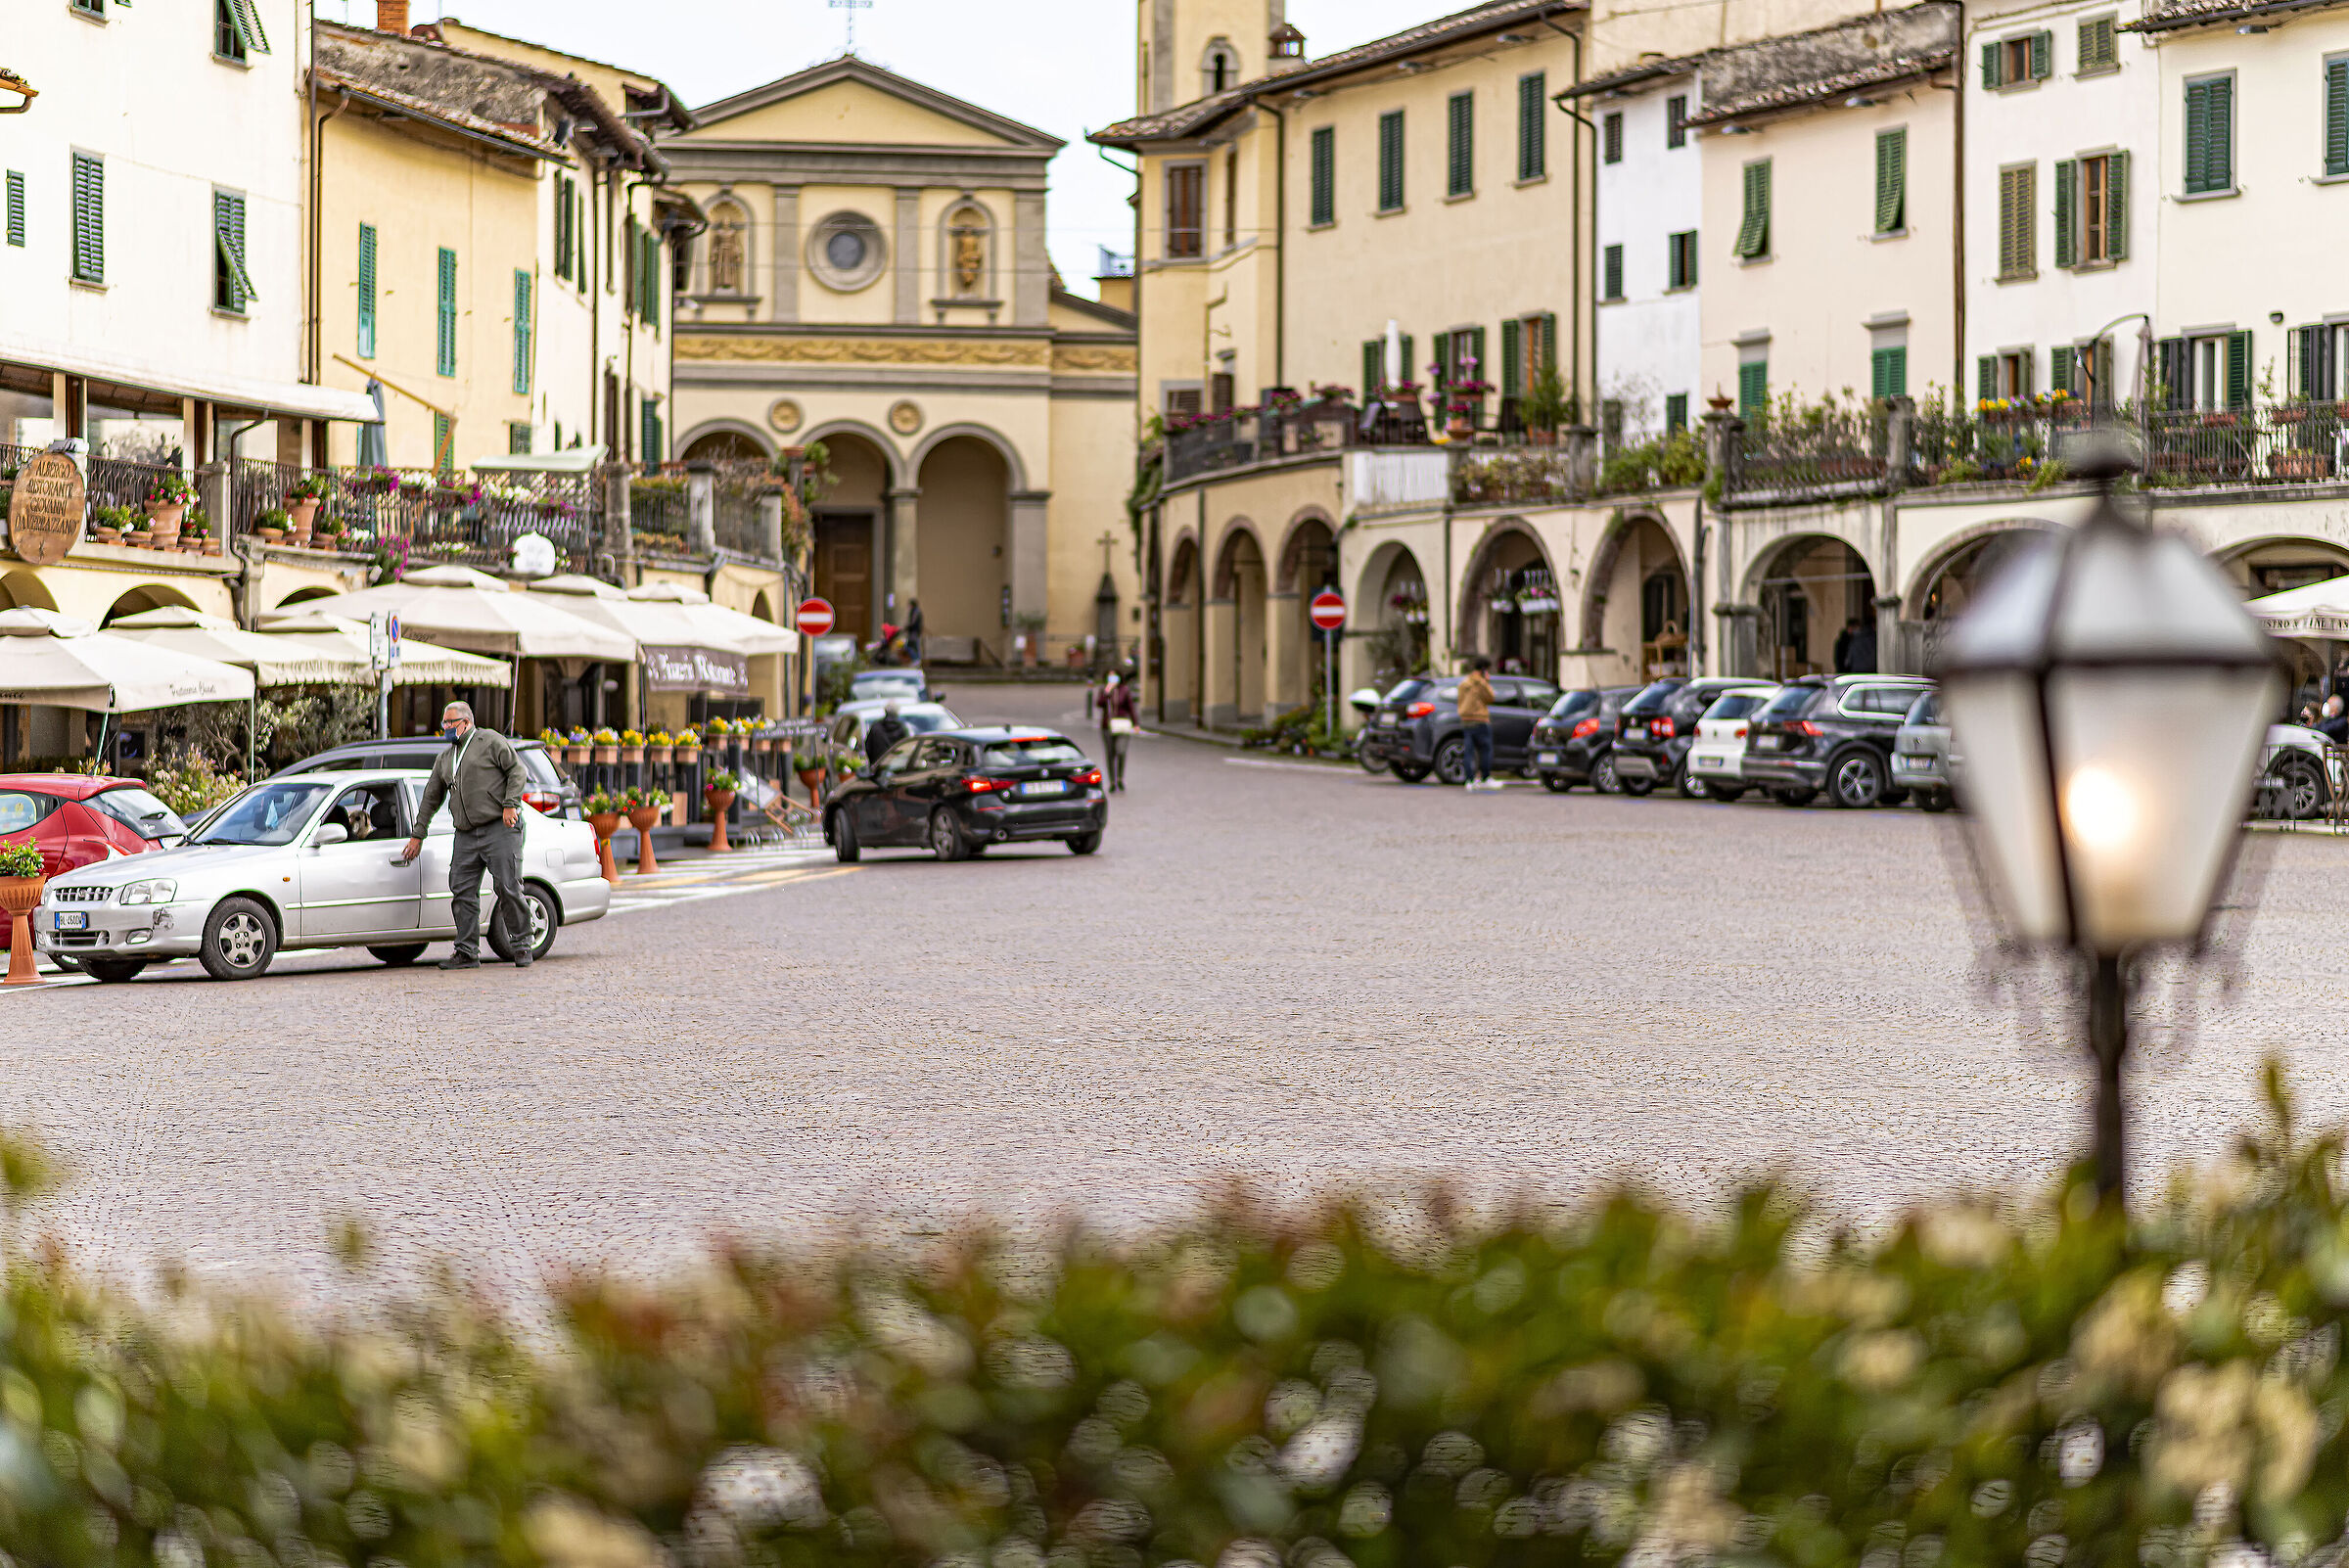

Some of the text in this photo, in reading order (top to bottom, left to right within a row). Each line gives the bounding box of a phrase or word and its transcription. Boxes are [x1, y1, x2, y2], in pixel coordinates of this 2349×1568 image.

[36, 461, 71, 479] ALBERGO
[26, 477, 74, 499] RISTORANTE
[29, 497, 68, 517] GIOVANNI
[2262, 618, 2290, 629] ISTRO
